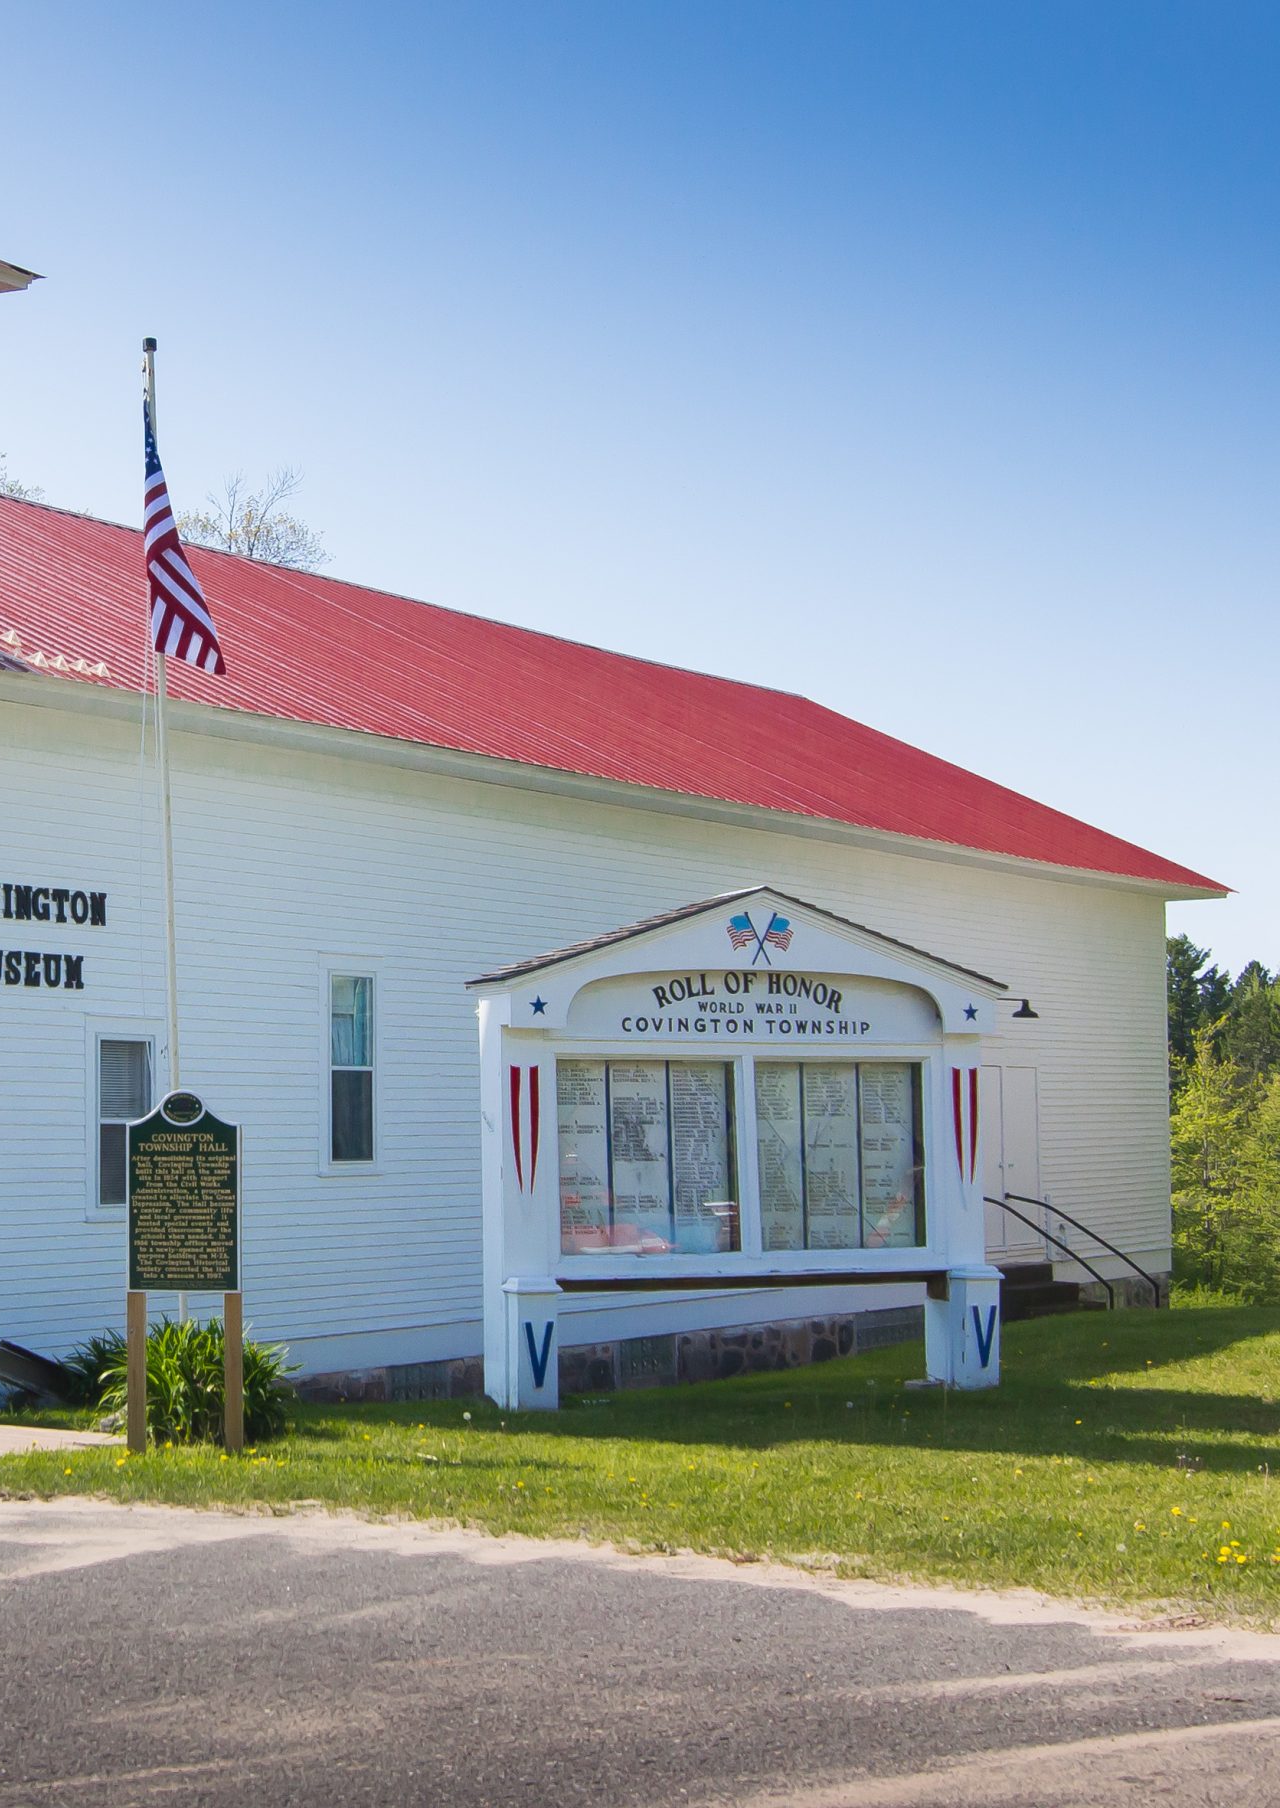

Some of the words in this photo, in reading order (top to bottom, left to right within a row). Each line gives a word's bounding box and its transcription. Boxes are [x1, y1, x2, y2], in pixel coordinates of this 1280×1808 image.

[652, 973, 715, 1009] ROLL
[724, 971, 757, 994] OF
[767, 972, 843, 1014] HONOR
[698, 1001, 745, 1014] WORLD
[756, 1003, 784, 1014] WAR
[789, 1003, 798, 1015] II
[621, 1017, 755, 1034] COVINGTON
[765, 1019, 871, 1035] TOWNSHIP
[152, 1133, 213, 1142] COVINGTON
[138, 1142, 193, 1152] TOWNSHIP
[199, 1142, 228, 1152] HALL
[972, 1304, 997, 1369] V
[524, 1321, 555, 1389] V
